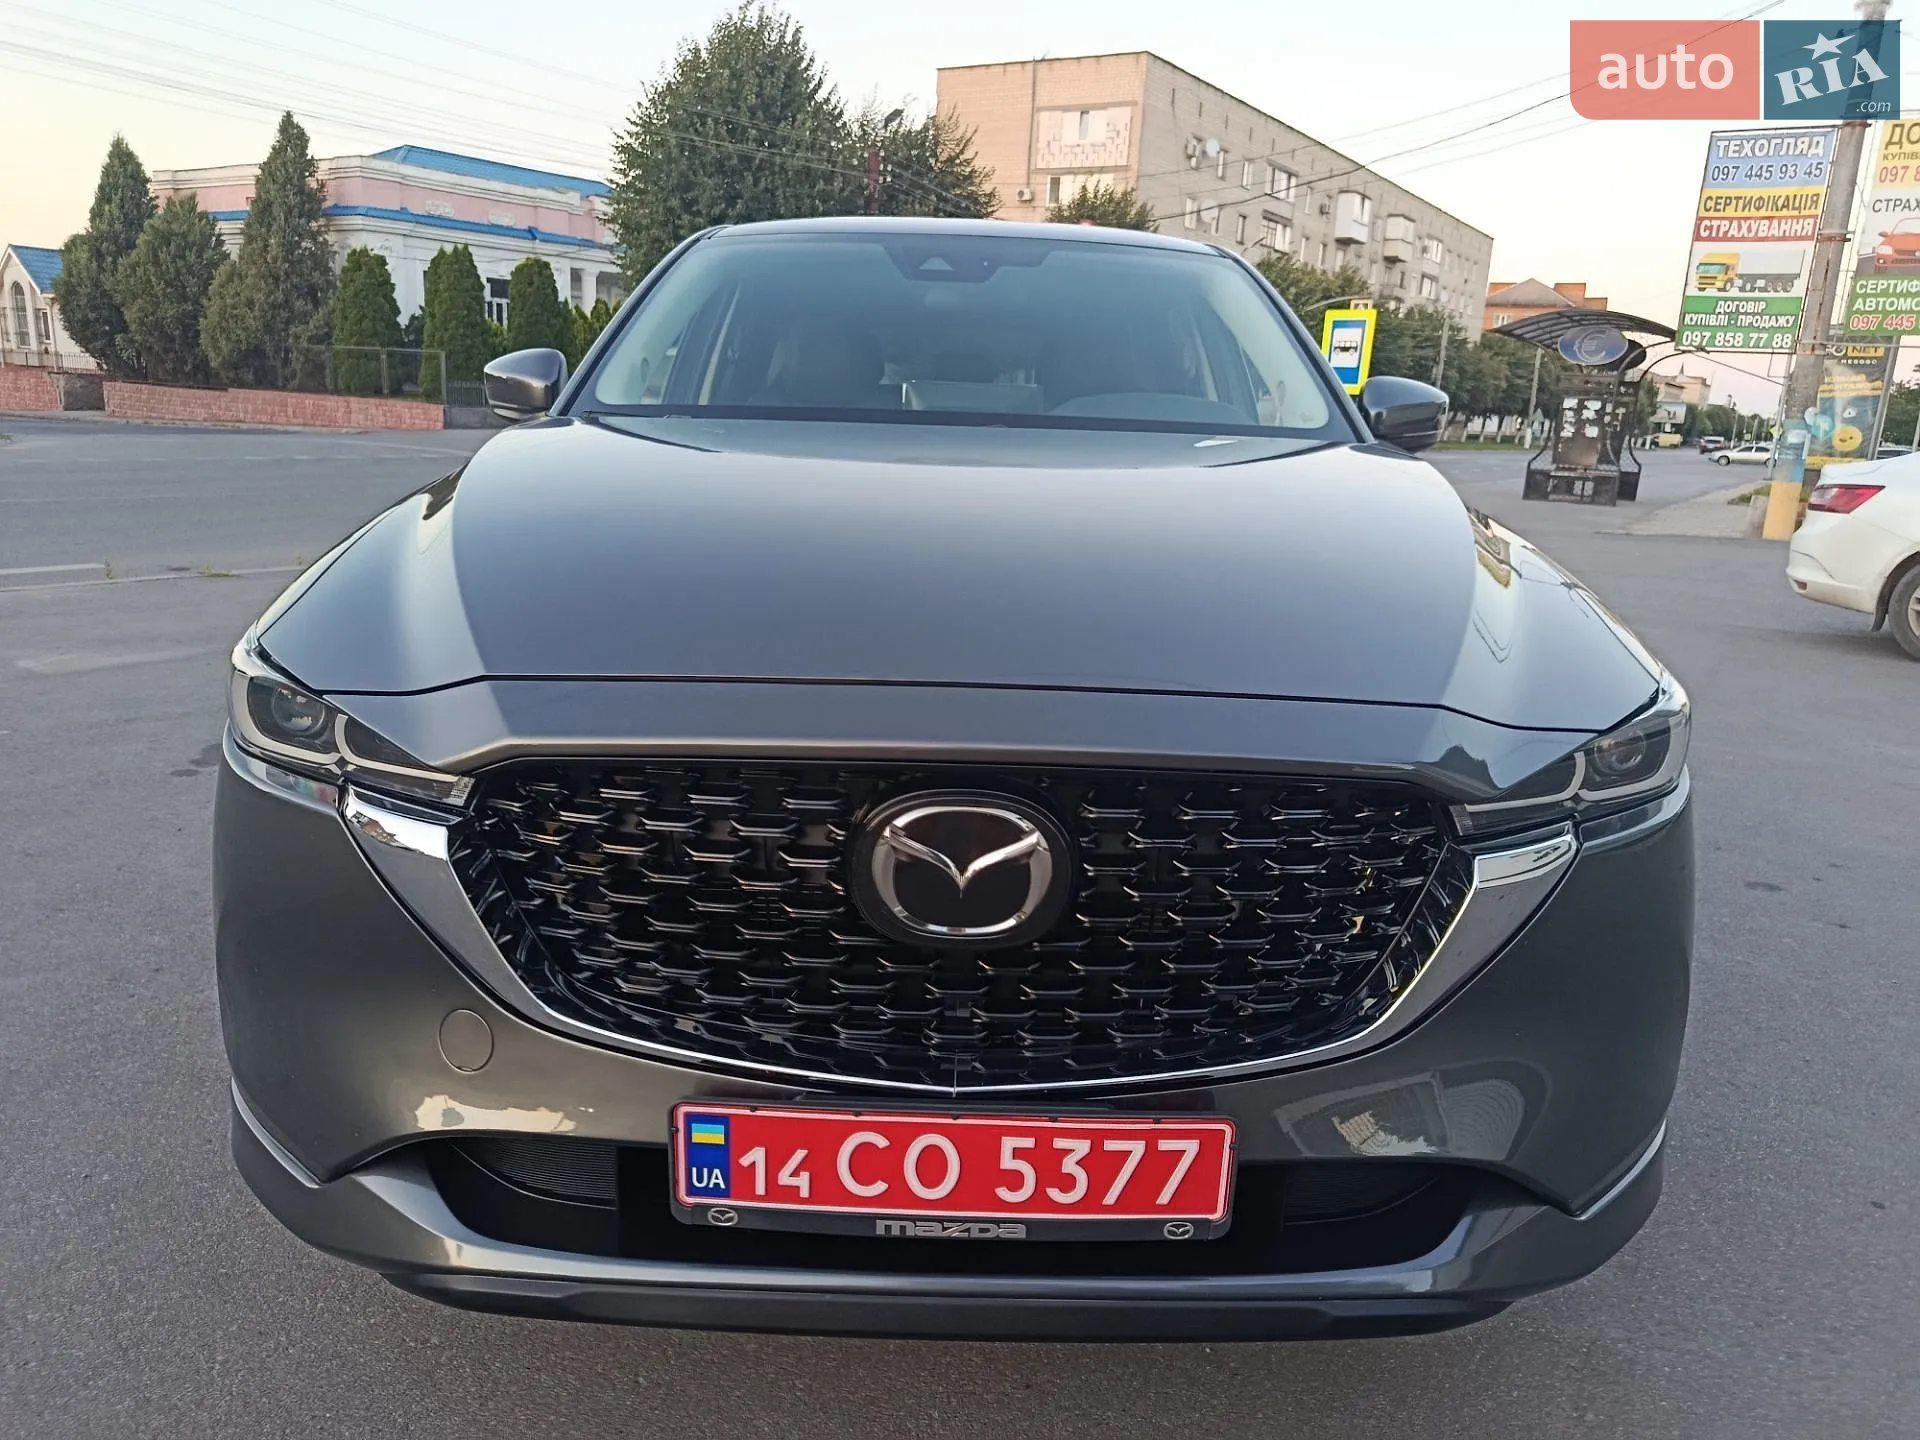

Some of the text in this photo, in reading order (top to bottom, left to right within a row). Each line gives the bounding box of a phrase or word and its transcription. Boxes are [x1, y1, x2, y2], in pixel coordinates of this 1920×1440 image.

[1716, 135, 1825, 158] ТЕХОГЛЯД
[1711, 161, 1823, 182] 097 445 93 45
[1879, 166, 1909, 183] 097
[1703, 193, 1820, 212] СЕРТИФІКАЦІЯ
[1700, 218, 1815, 238] СТРАХУВАННЯ
[1716, 300, 1767, 313] ДОГОВІР
[1684, 314, 1728, 327] КУПІВЛІ
[1737, 314, 1795, 328] ПРОДАЖУ
[1850, 314, 1915, 329] 097 445
[1682, 332, 1792, 347] 097 858 77 88
[738, 1131, 1200, 1205] 14 CO 5377
[691, 1167, 725, 1190] UA
